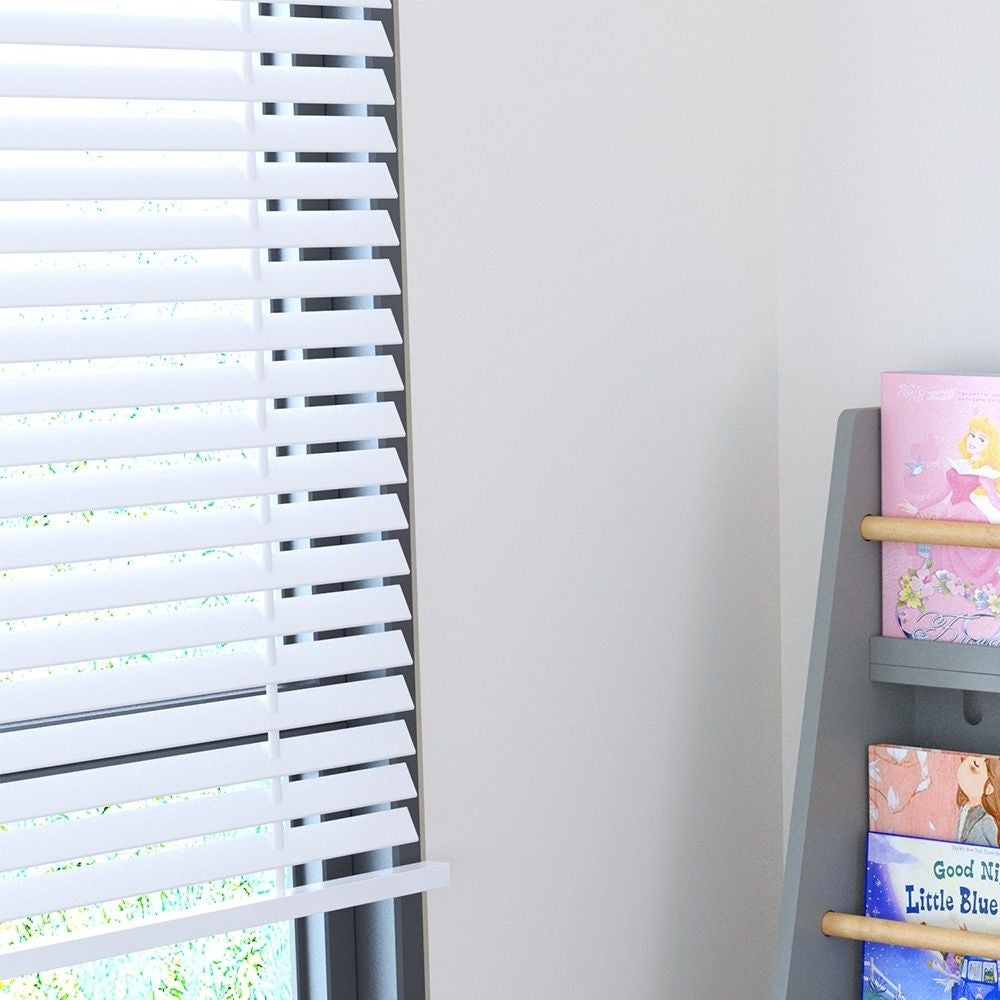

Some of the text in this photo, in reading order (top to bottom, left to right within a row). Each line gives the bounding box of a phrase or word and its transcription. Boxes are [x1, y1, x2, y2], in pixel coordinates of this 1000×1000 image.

[933, 859, 974, 880] Good
[905, 885, 954, 914] Little
[959, 886, 998, 915] Blue
